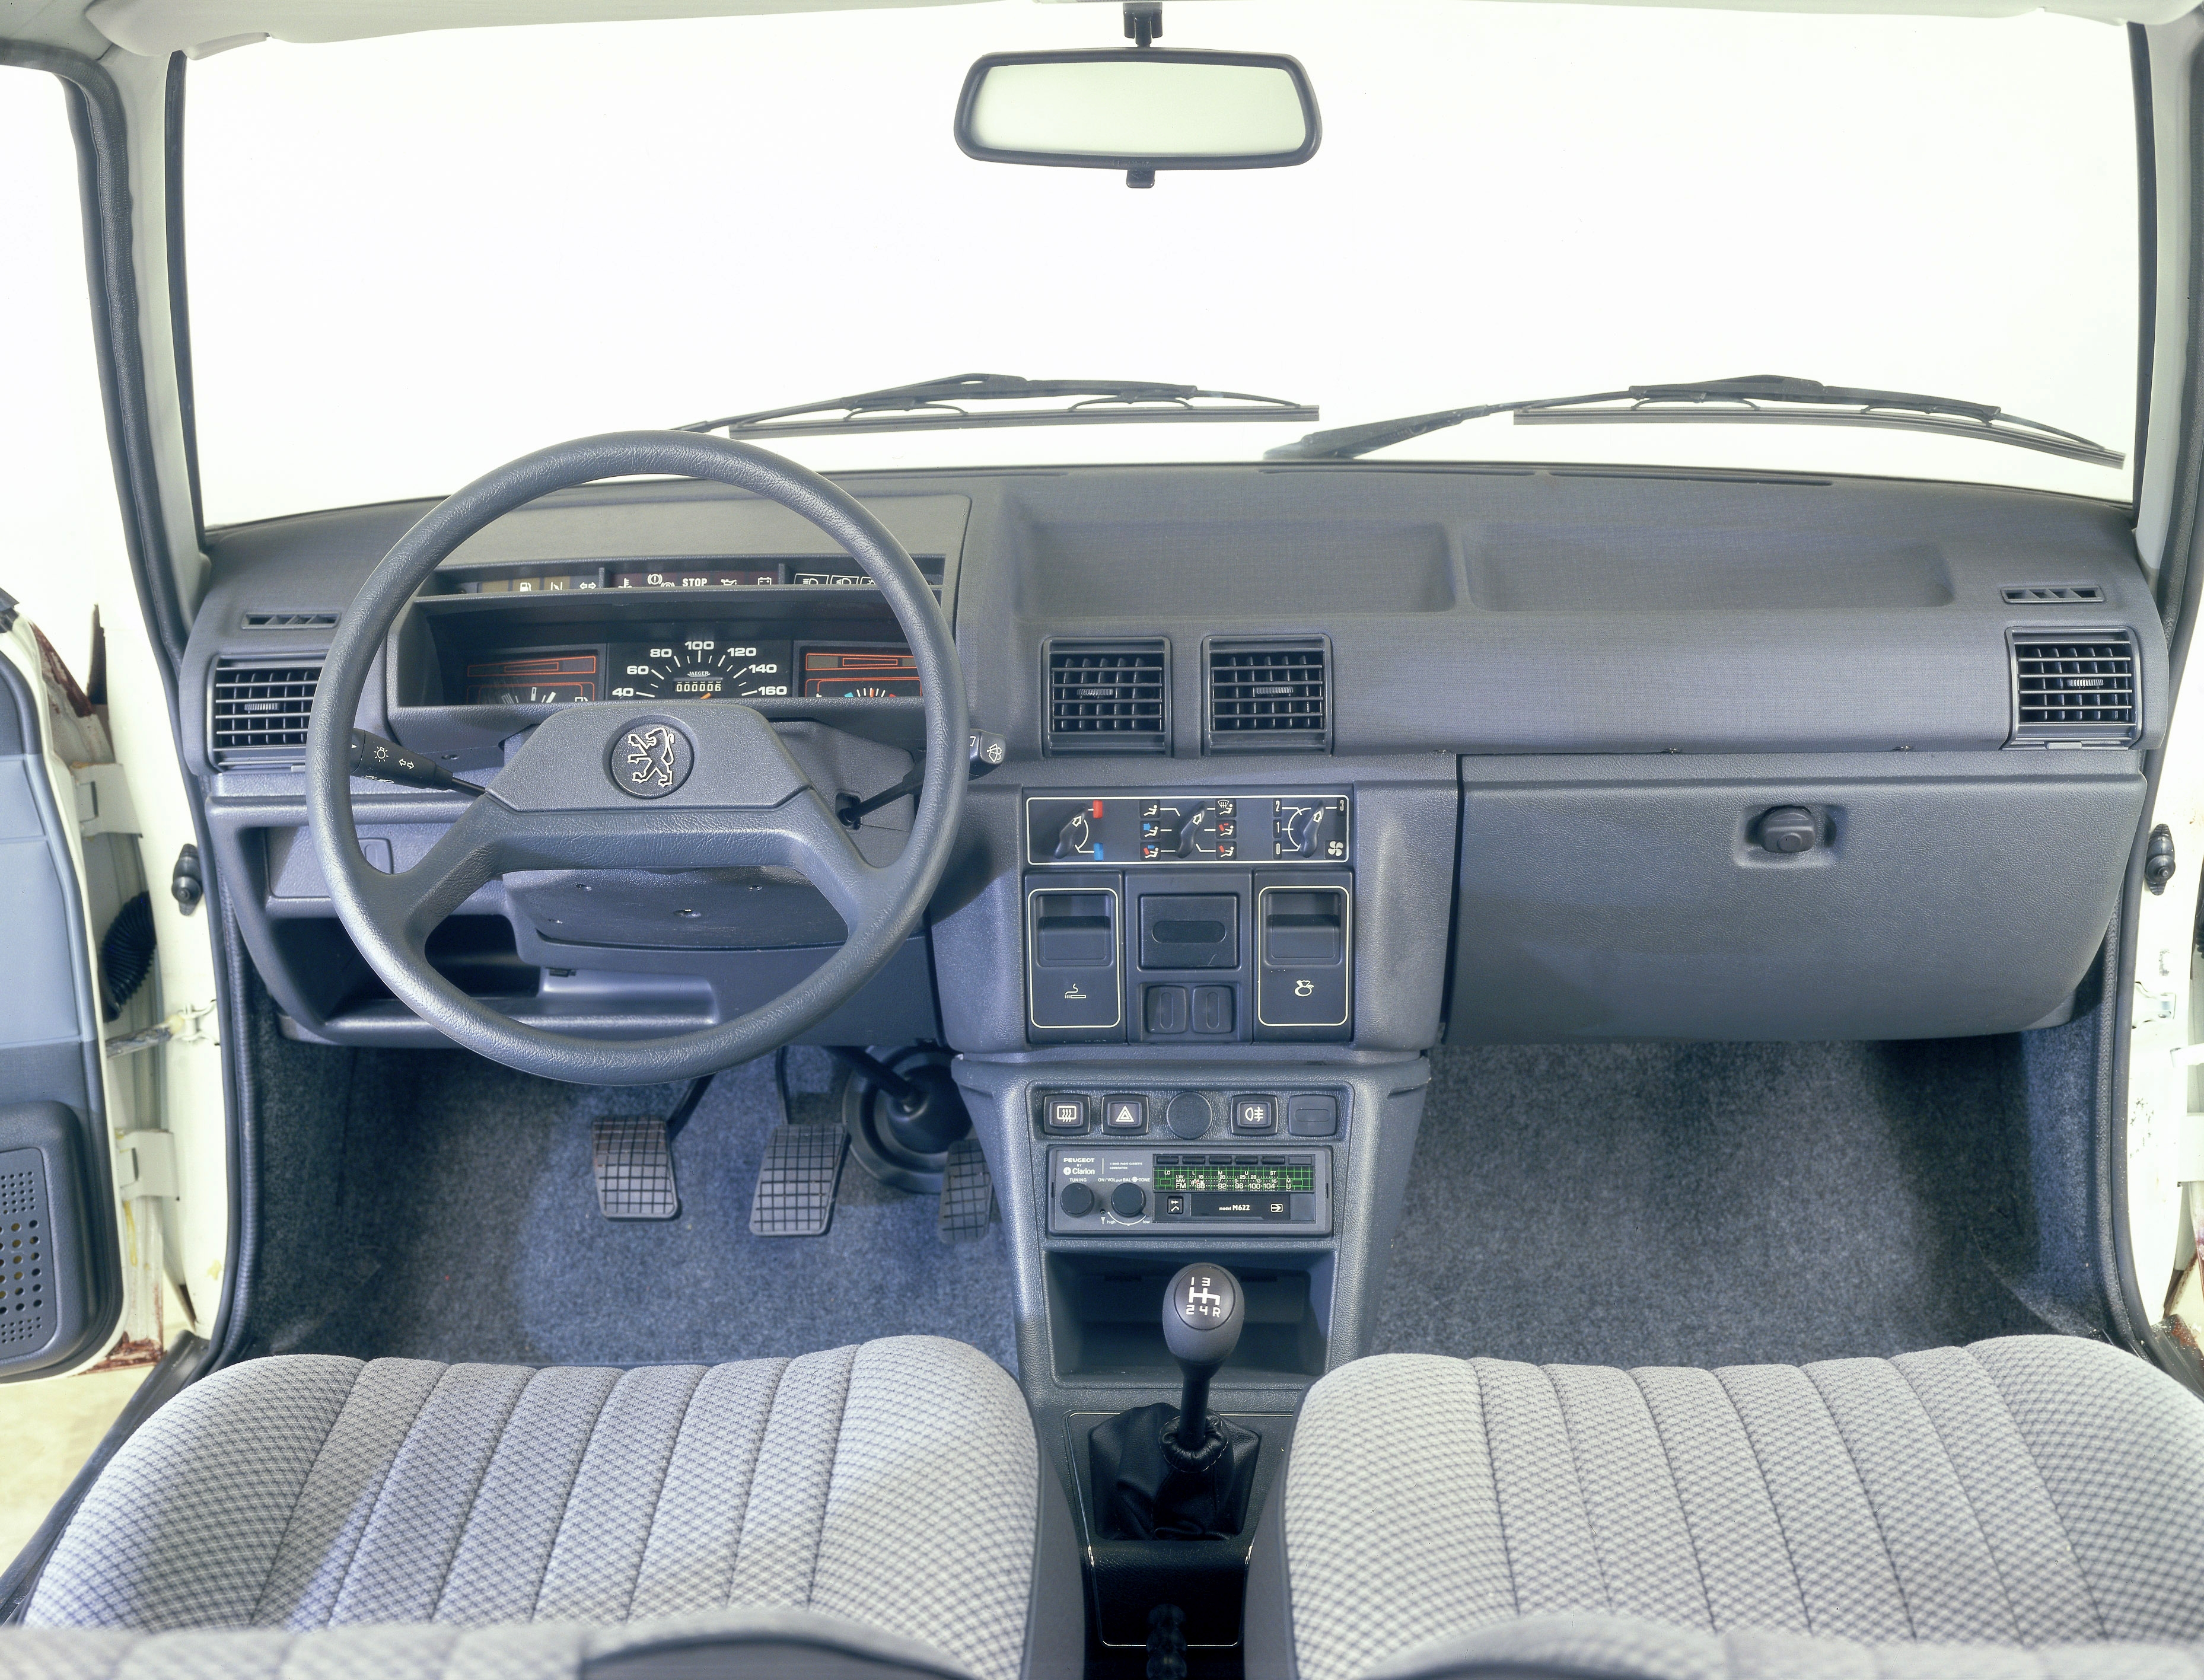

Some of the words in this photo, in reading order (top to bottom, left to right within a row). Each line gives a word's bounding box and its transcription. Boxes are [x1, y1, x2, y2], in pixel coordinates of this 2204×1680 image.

[682, 578, 708, 586] STOP
[684, 641, 715, 650] 100
[649, 648, 673, 658] 80
[727, 648, 757, 656] 120
[626, 665, 649, 675] 60
[748, 664, 778, 673] 140
[611, 687, 634, 697] 40
[676, 683, 722, 692] 000006
[757, 686, 788, 696] 160
[1275, 800, 1281, 812] 2
[1340, 799, 1345, 811] 3
[1276, 821, 1280, 833] 1
[1276, 843, 1281, 855] 0
[1191, 1277, 1195, 1285] 1
[1202, 1277, 1211, 1287] 3
[1186, 1305, 1195, 1315] 2
[1199, 1306, 1208, 1315] 4
[1212, 1306, 1221, 1318] R
